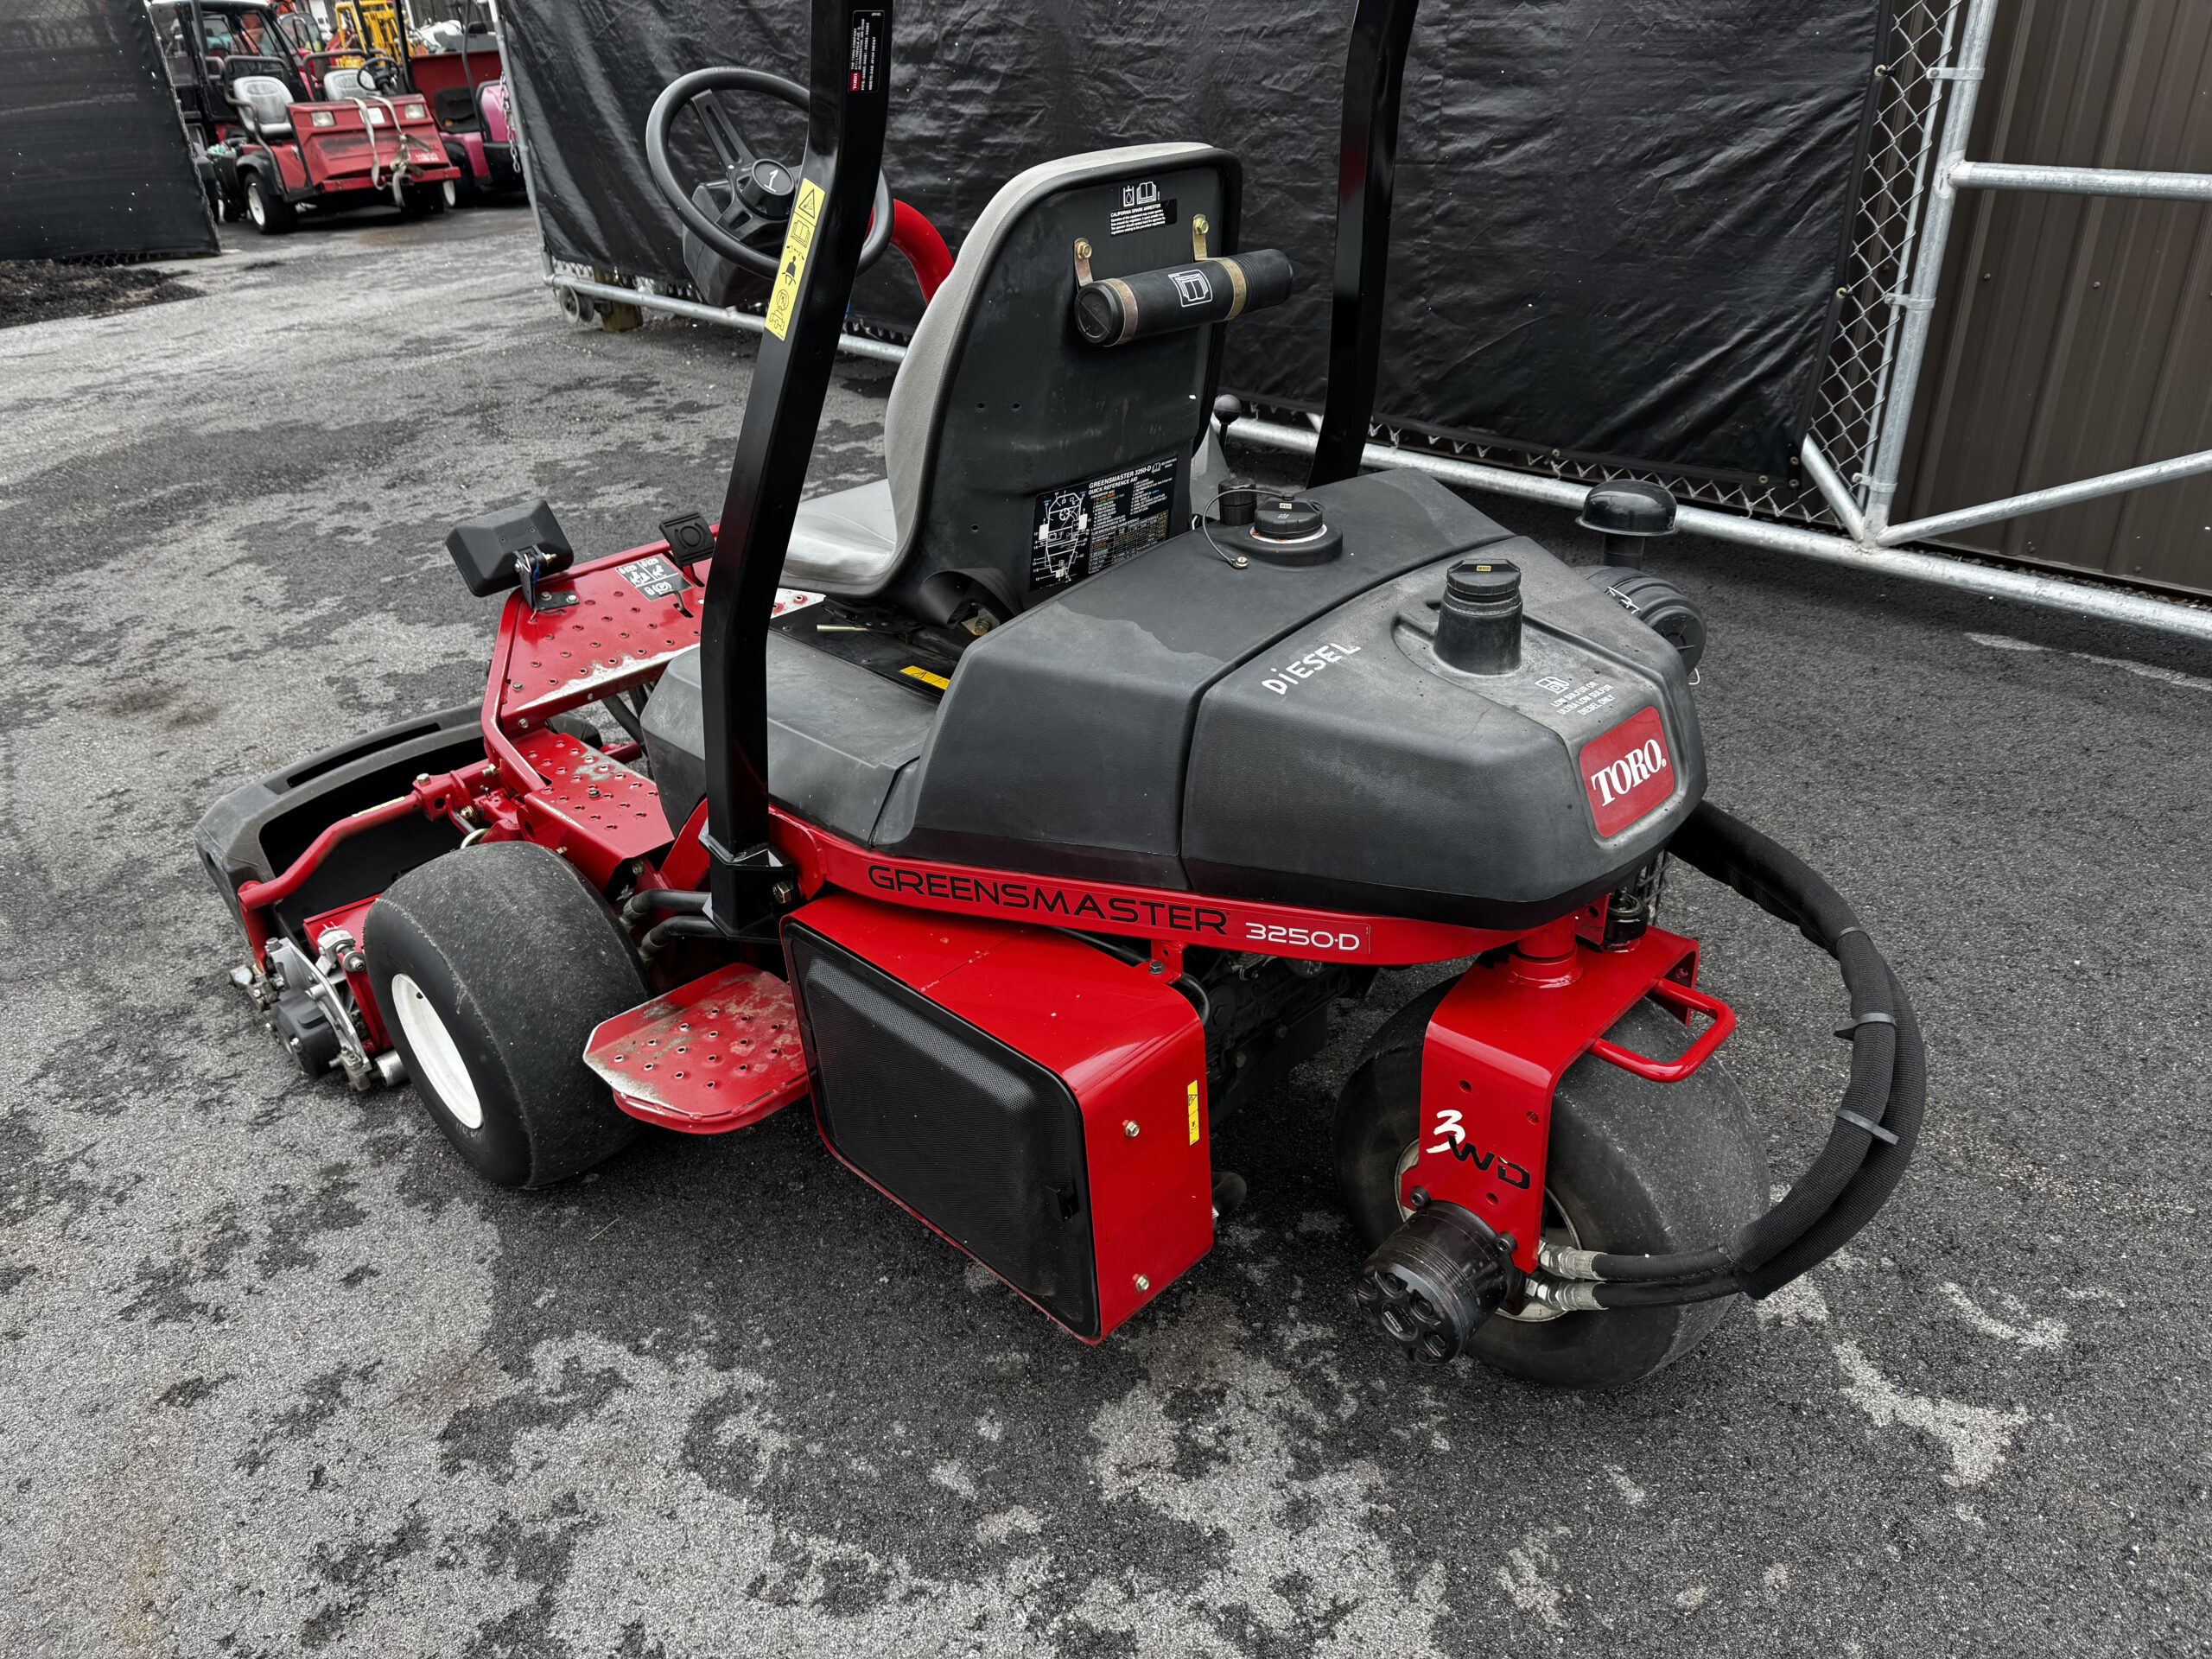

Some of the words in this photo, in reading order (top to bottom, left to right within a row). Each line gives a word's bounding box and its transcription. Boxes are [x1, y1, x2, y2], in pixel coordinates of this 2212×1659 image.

[1089, 471, 1135, 488] GREENSMASTER
[1089, 486, 1103, 495] QUICK
[1103, 479, 1130, 491] REFERENCE
[1597, 693, 1616, 705] ONLY
[1556, 702, 1580, 715] ULTRA
[868, 865, 1228, 935] GREENSMASTER
